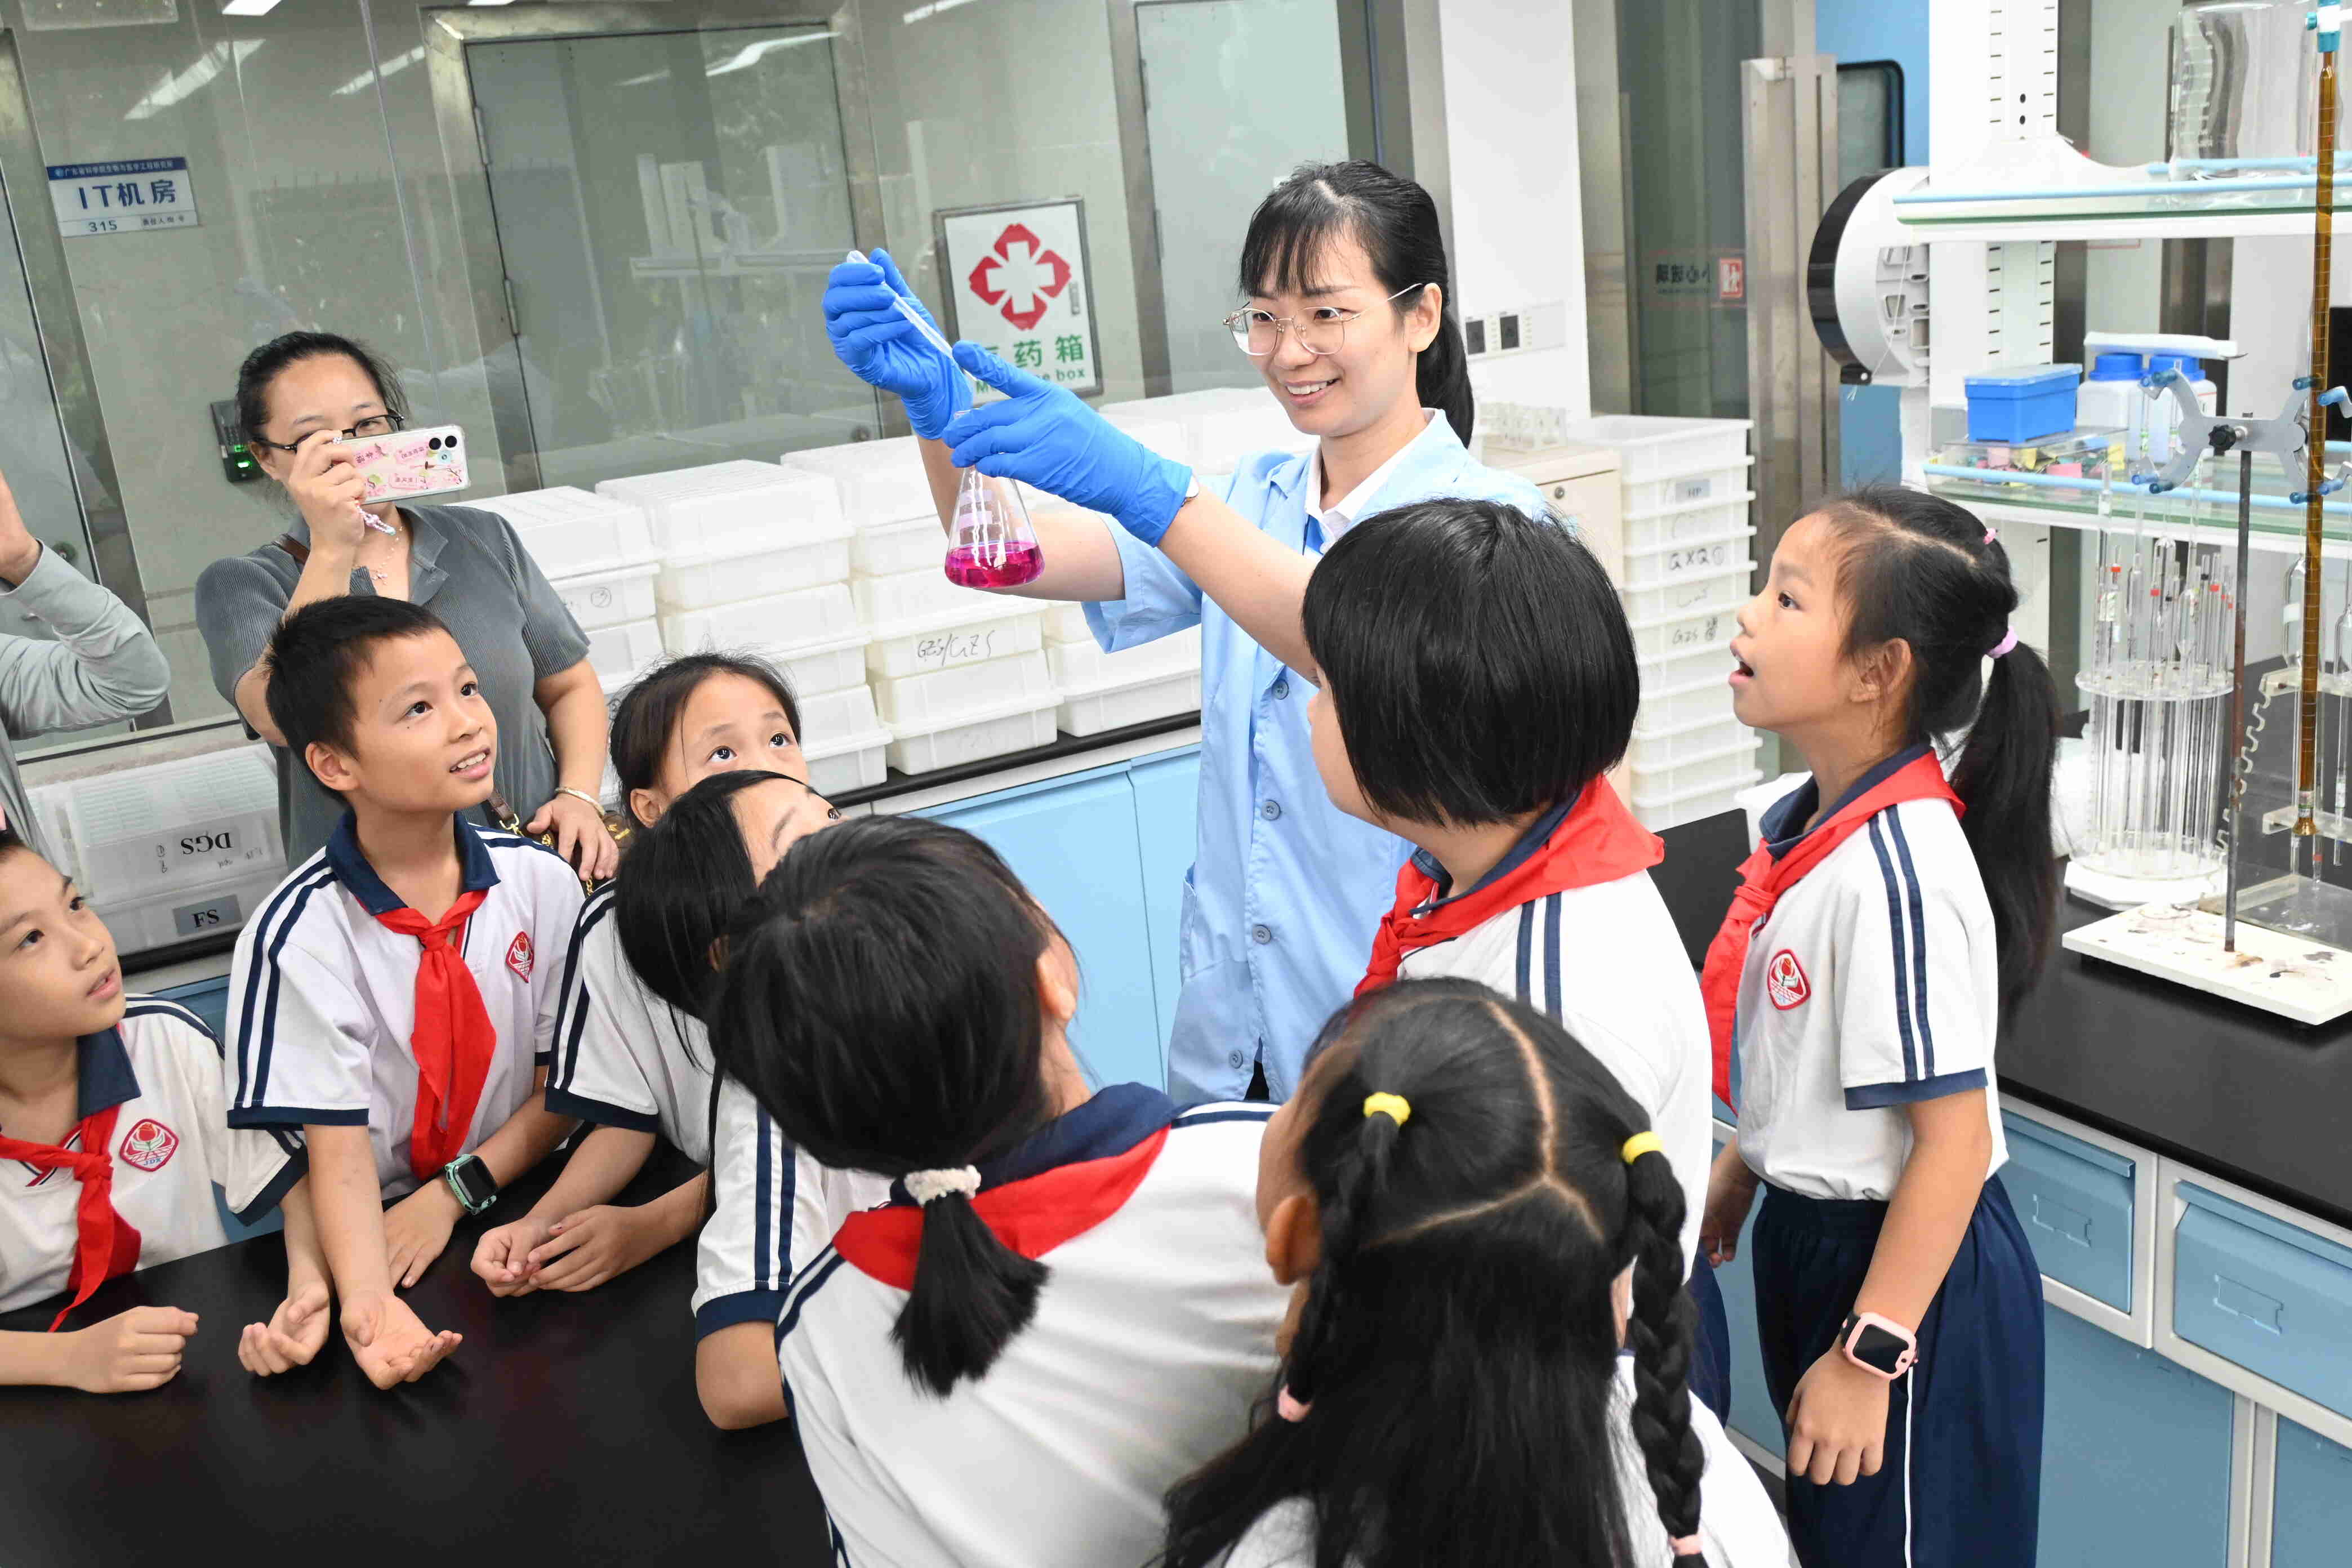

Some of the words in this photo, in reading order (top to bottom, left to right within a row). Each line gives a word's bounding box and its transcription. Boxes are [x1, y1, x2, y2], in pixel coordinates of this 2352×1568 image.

[78, 179, 176, 210] IT机房
[88, 220, 118, 233] 315
[985, 333, 1084, 368] 药箱
[1055, 369, 1085, 382] box
[180, 832, 234, 855] DGS
[191, 909, 220, 928] FS
